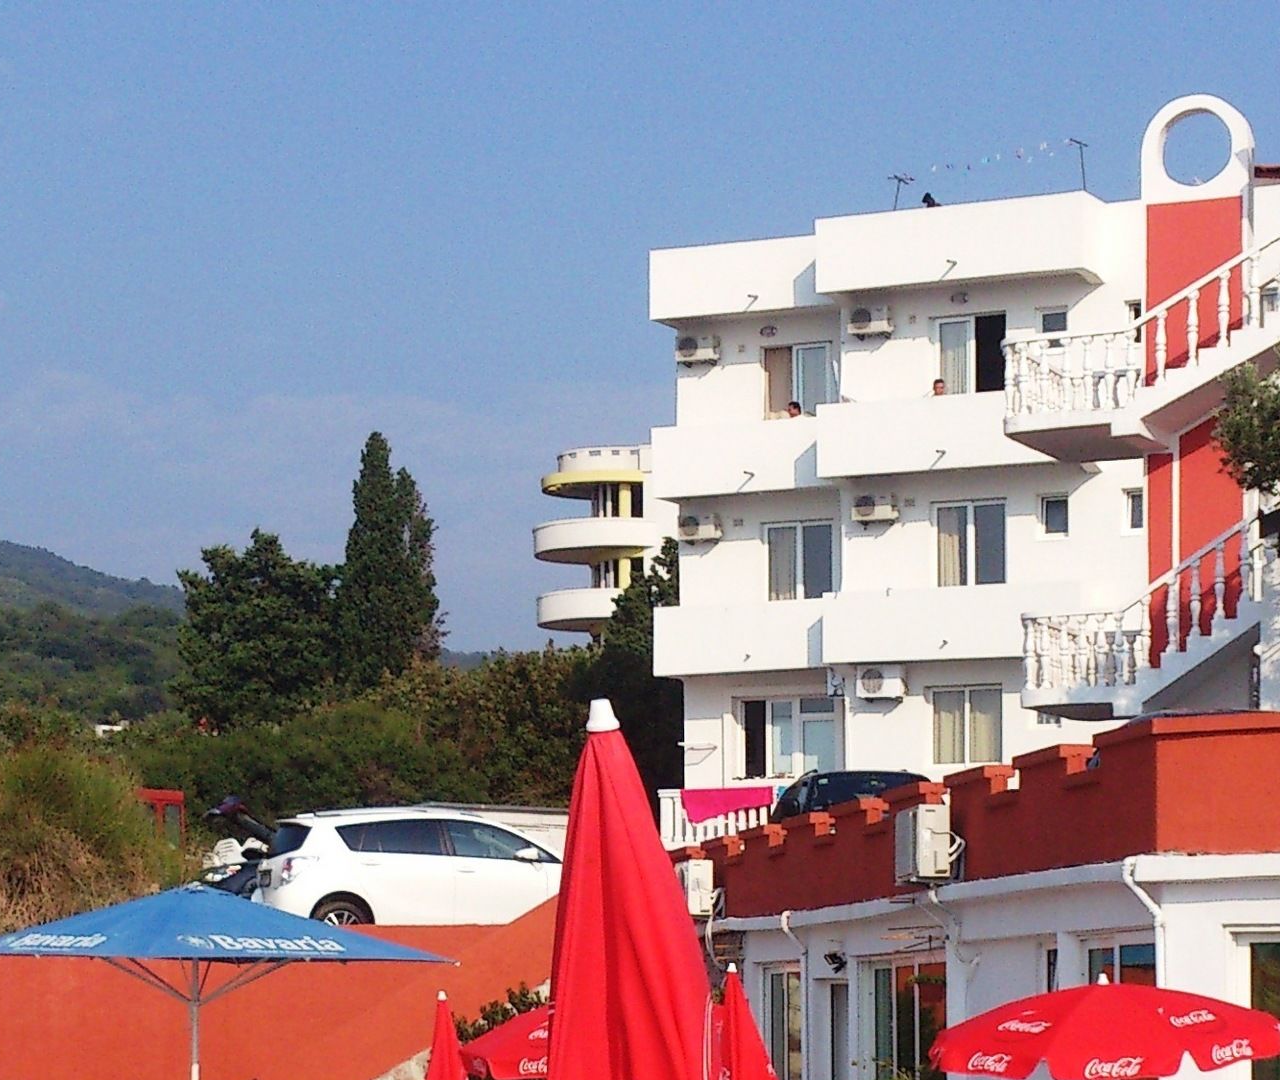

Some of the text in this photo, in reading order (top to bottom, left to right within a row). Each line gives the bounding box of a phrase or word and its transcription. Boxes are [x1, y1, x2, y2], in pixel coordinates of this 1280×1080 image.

[208, 934, 346, 952] Bavaria
[967, 1051, 1012, 1073] Coca-Cola
[1083, 1056, 1144, 1079] Coca-Cola
